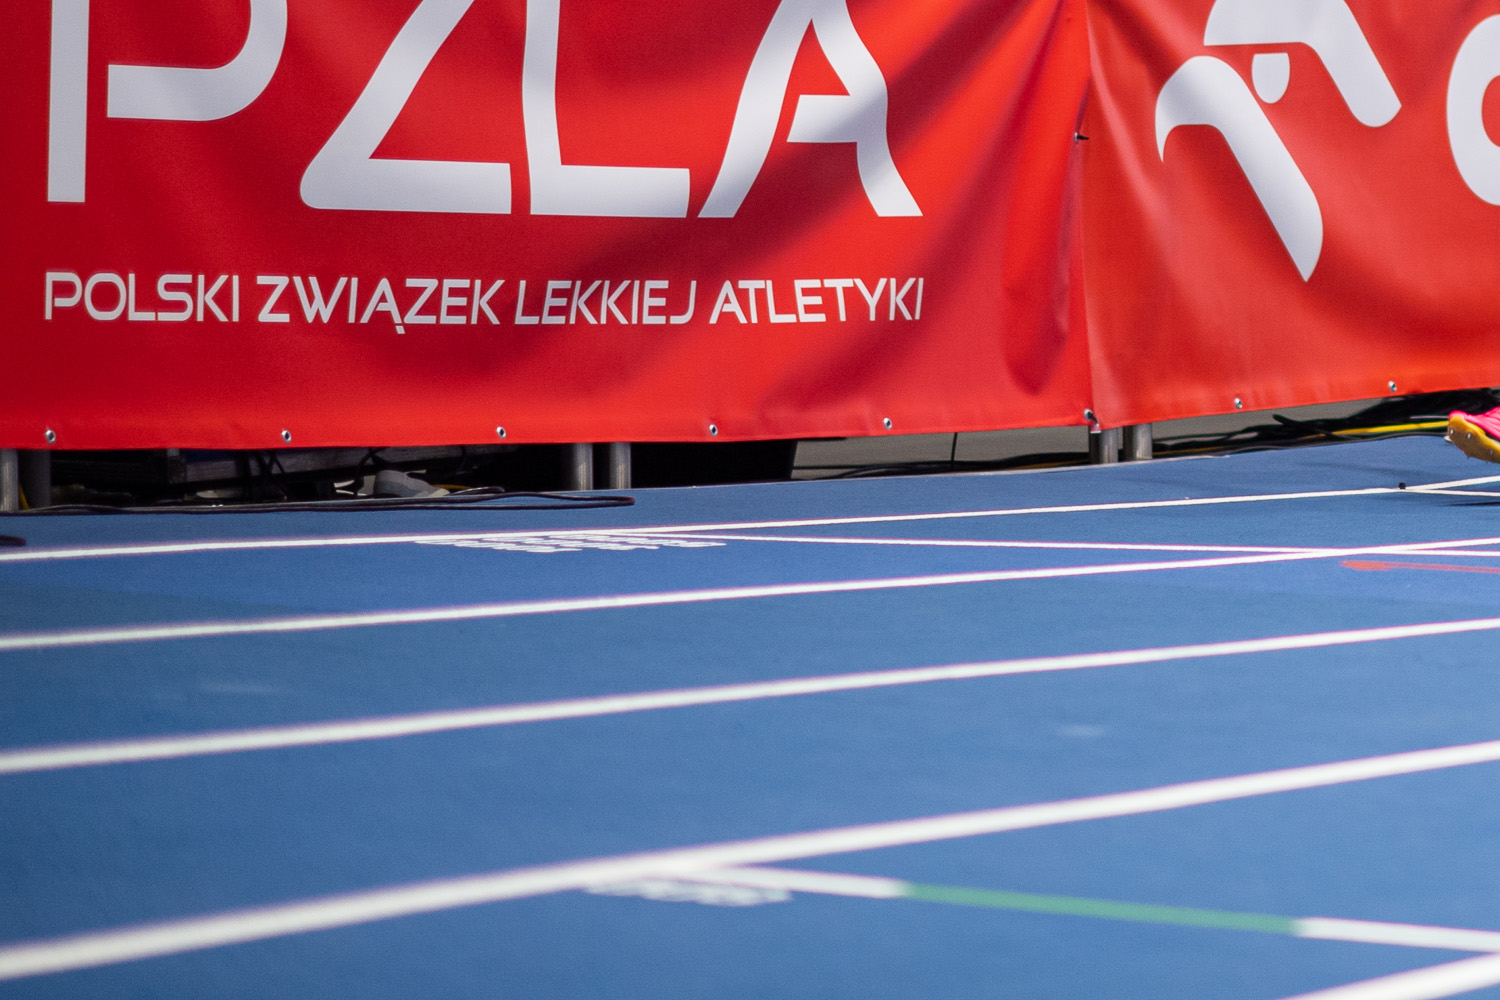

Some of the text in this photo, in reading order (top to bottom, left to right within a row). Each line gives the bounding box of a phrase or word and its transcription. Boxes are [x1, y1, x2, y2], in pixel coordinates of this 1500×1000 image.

[44, 271, 924, 335] POLSKI ZWIĄZEK LEKKIEJ ATLETYKI
